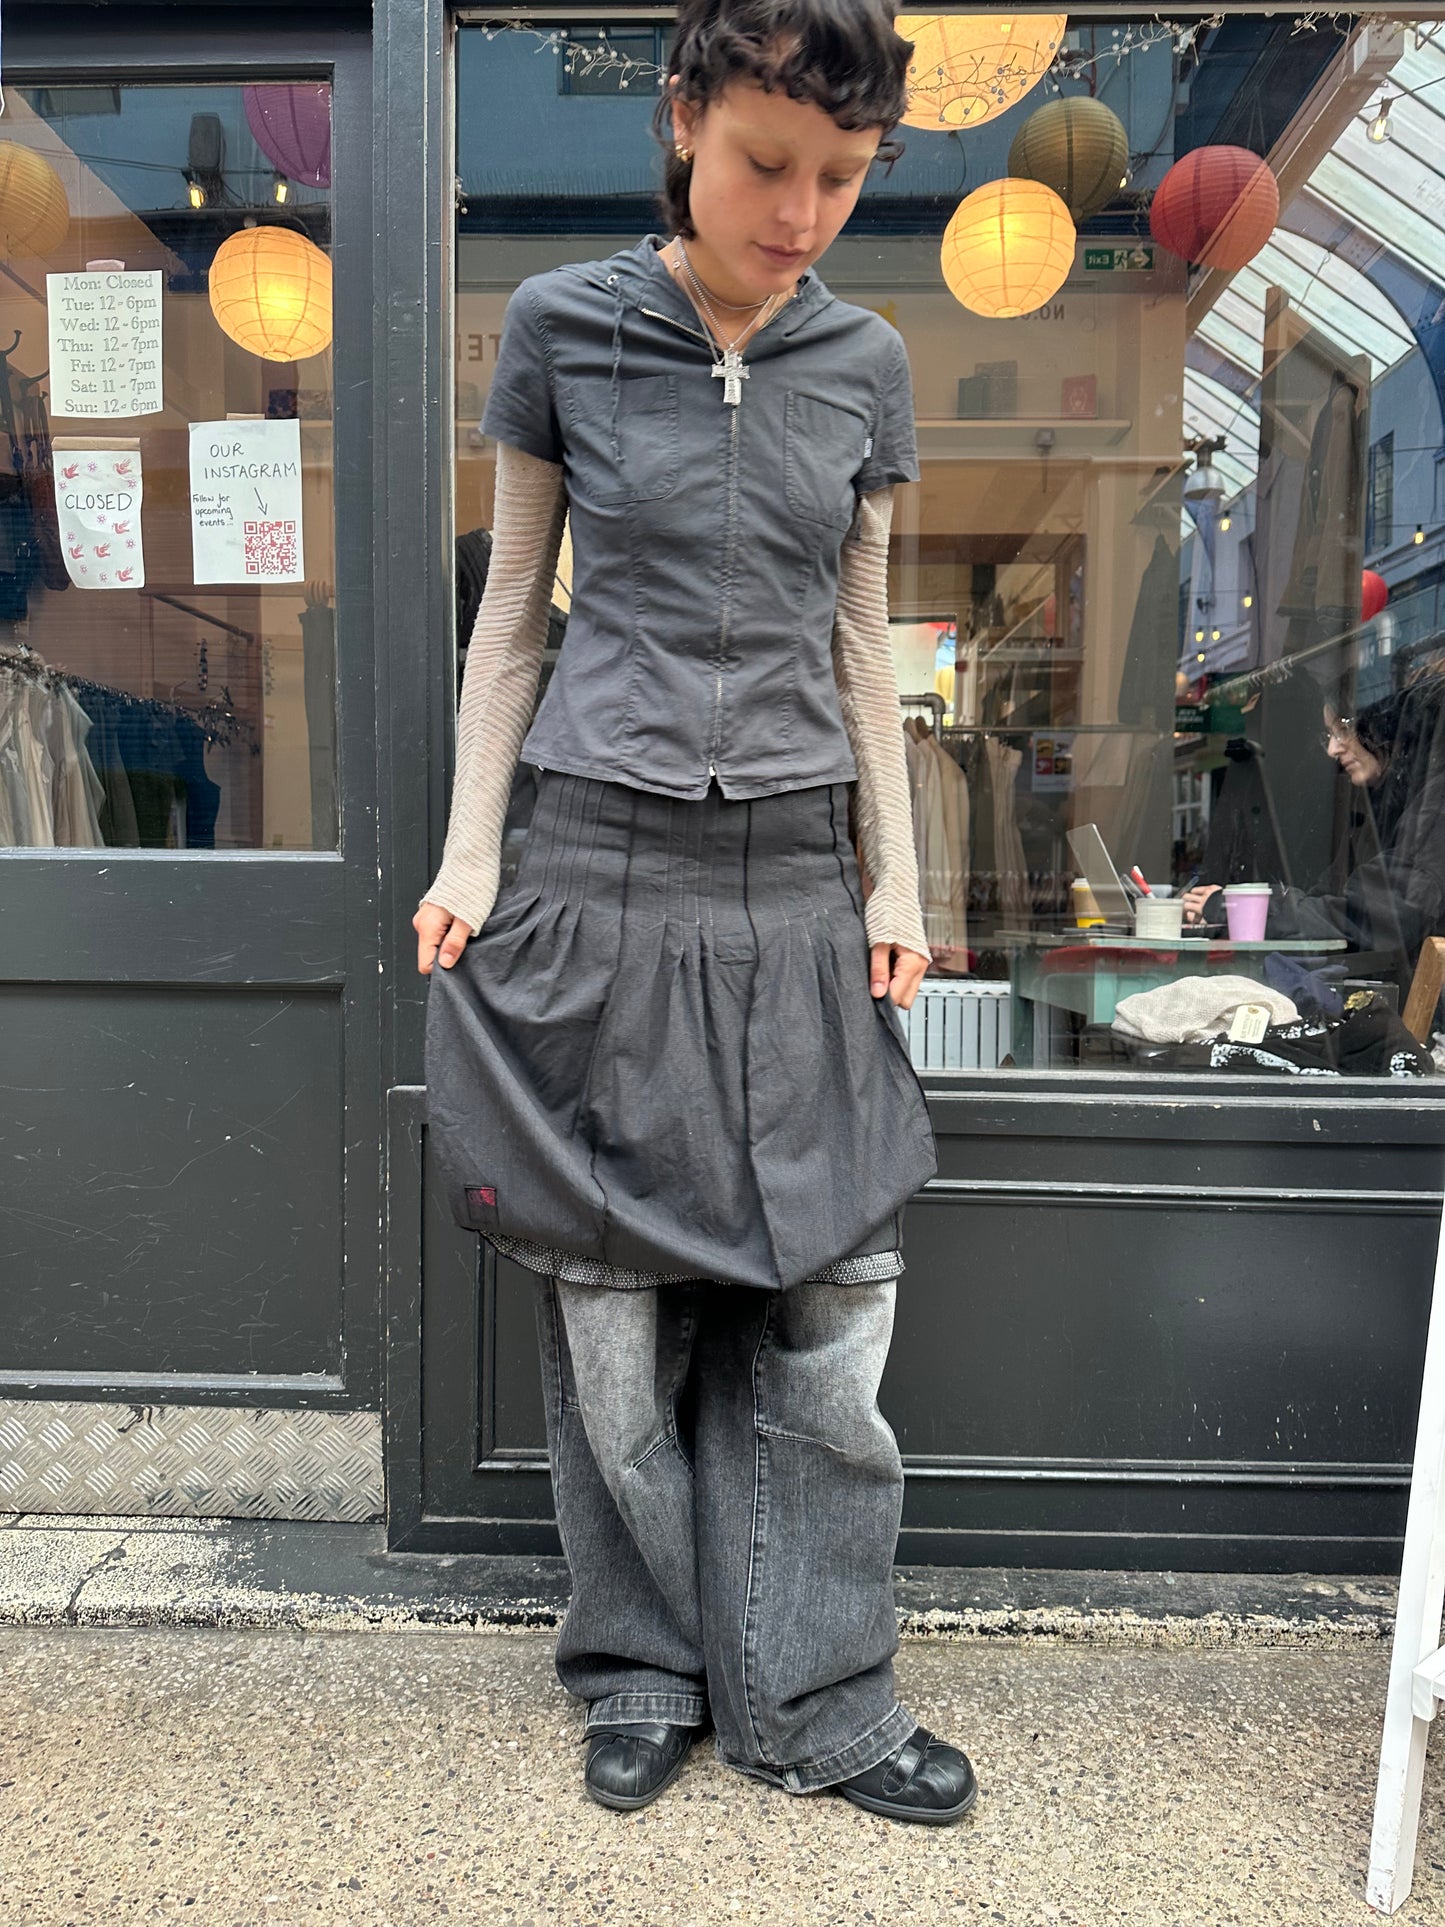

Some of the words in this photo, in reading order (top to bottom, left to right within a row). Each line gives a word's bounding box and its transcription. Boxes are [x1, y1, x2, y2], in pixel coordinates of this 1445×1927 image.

[63, 277, 101, 290] Mon:
[106, 274, 153, 289] Closed
[61, 297, 95, 311] Tue:
[99, 295, 116, 310] 12
[126, 295, 157, 312] 6pm
[59, 318, 100, 331] Wed:
[104, 316, 120, 331] 12
[131, 316, 160, 333] 6pm
[57, 338, 94, 352] Thu:
[103, 336, 120, 352] 12
[131, 336, 159, 354] 7pm
[70, 359, 96, 372] Fri:
[101, 357, 117, 372] 12
[128, 358, 156, 375] 7pm
[70, 379, 98, 393] Sat:
[102, 379, 116, 393] 11
[129, 378, 157, 395] 7pm
[64, 399, 98, 413] Sun:
[103, 398, 120, 413] 12
[130, 397, 159, 415] 6pm
[210, 442, 245, 458] OUR
[204, 462, 297, 480] INSTAGRAM
[64, 492, 133, 512] CLOSED
[192, 493, 214, 503] Follow
[216, 493, 231, 508] for
[194, 506, 234, 520] upcoming
